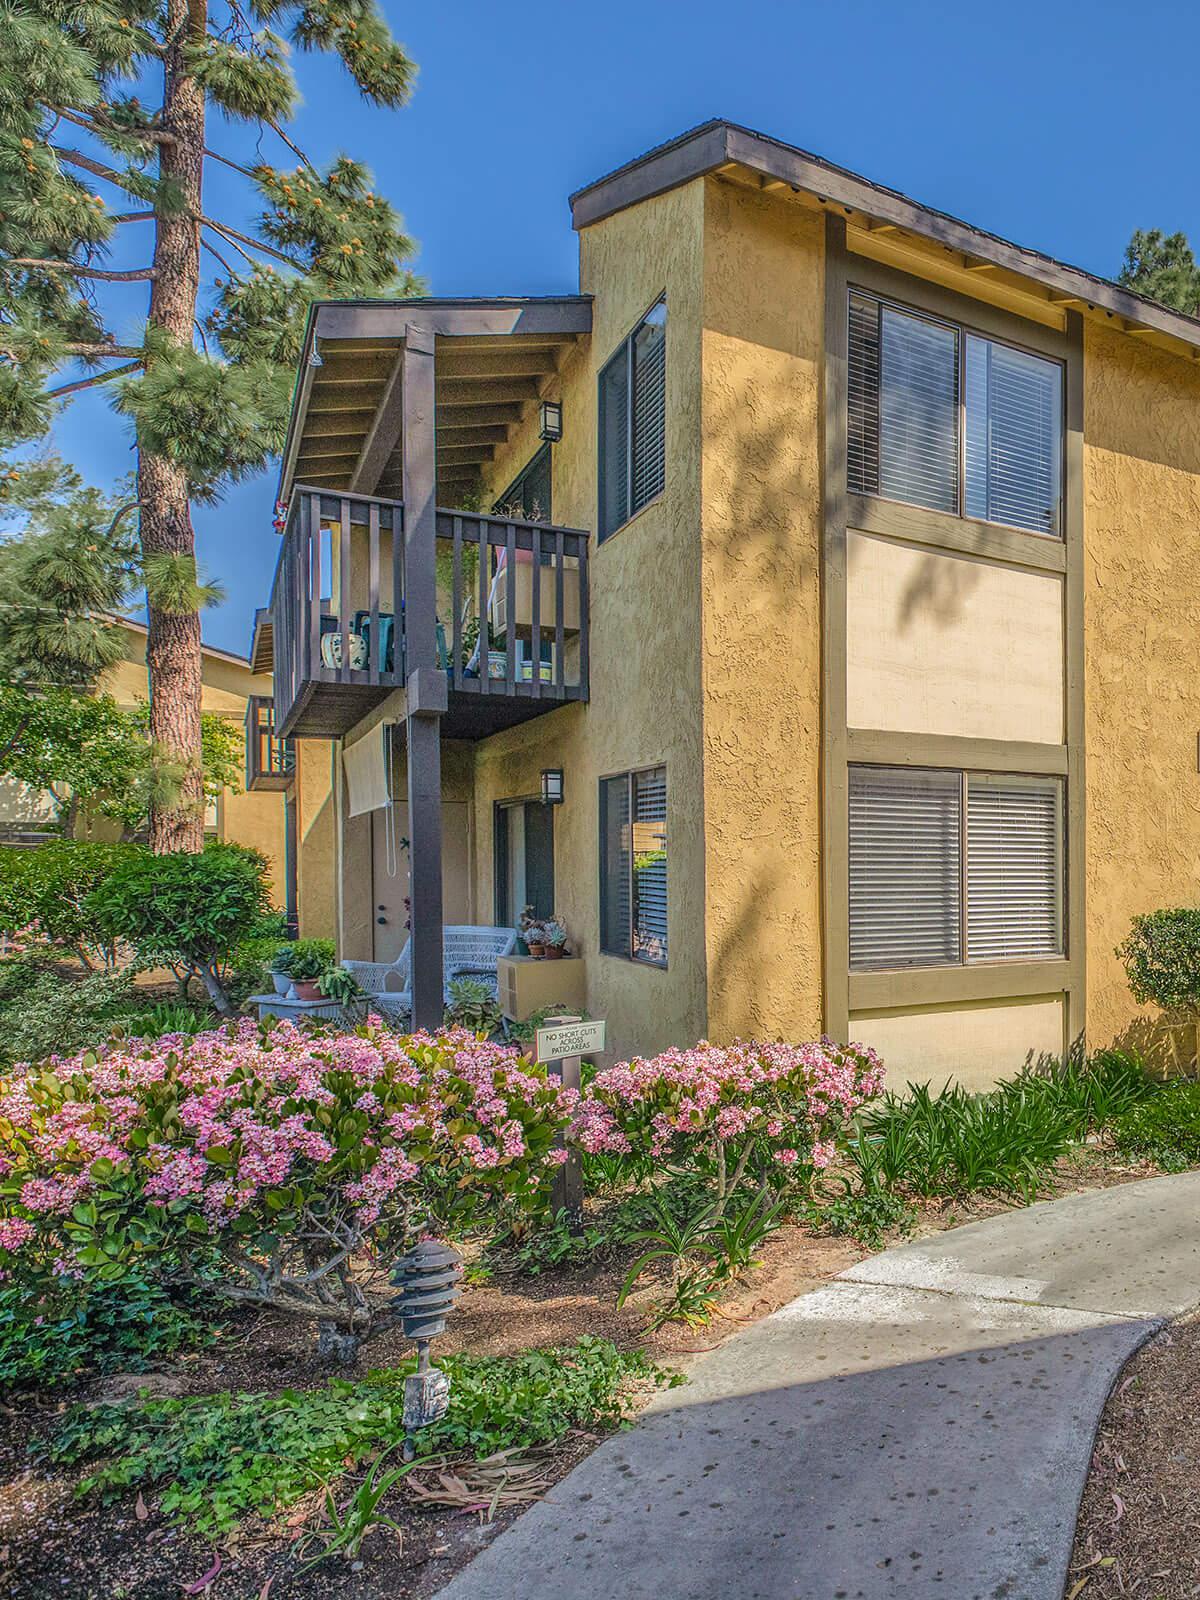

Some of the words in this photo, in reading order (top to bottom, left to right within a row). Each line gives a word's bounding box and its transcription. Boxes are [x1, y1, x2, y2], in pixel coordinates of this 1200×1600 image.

[558, 1030, 579, 1040] SHORT
[580, 1028, 597, 1036] CUTS
[560, 1037, 584, 1046] ACROSS
[551, 1046, 570, 1055] PATIO
[570, 1042, 590, 1051] AREAS
